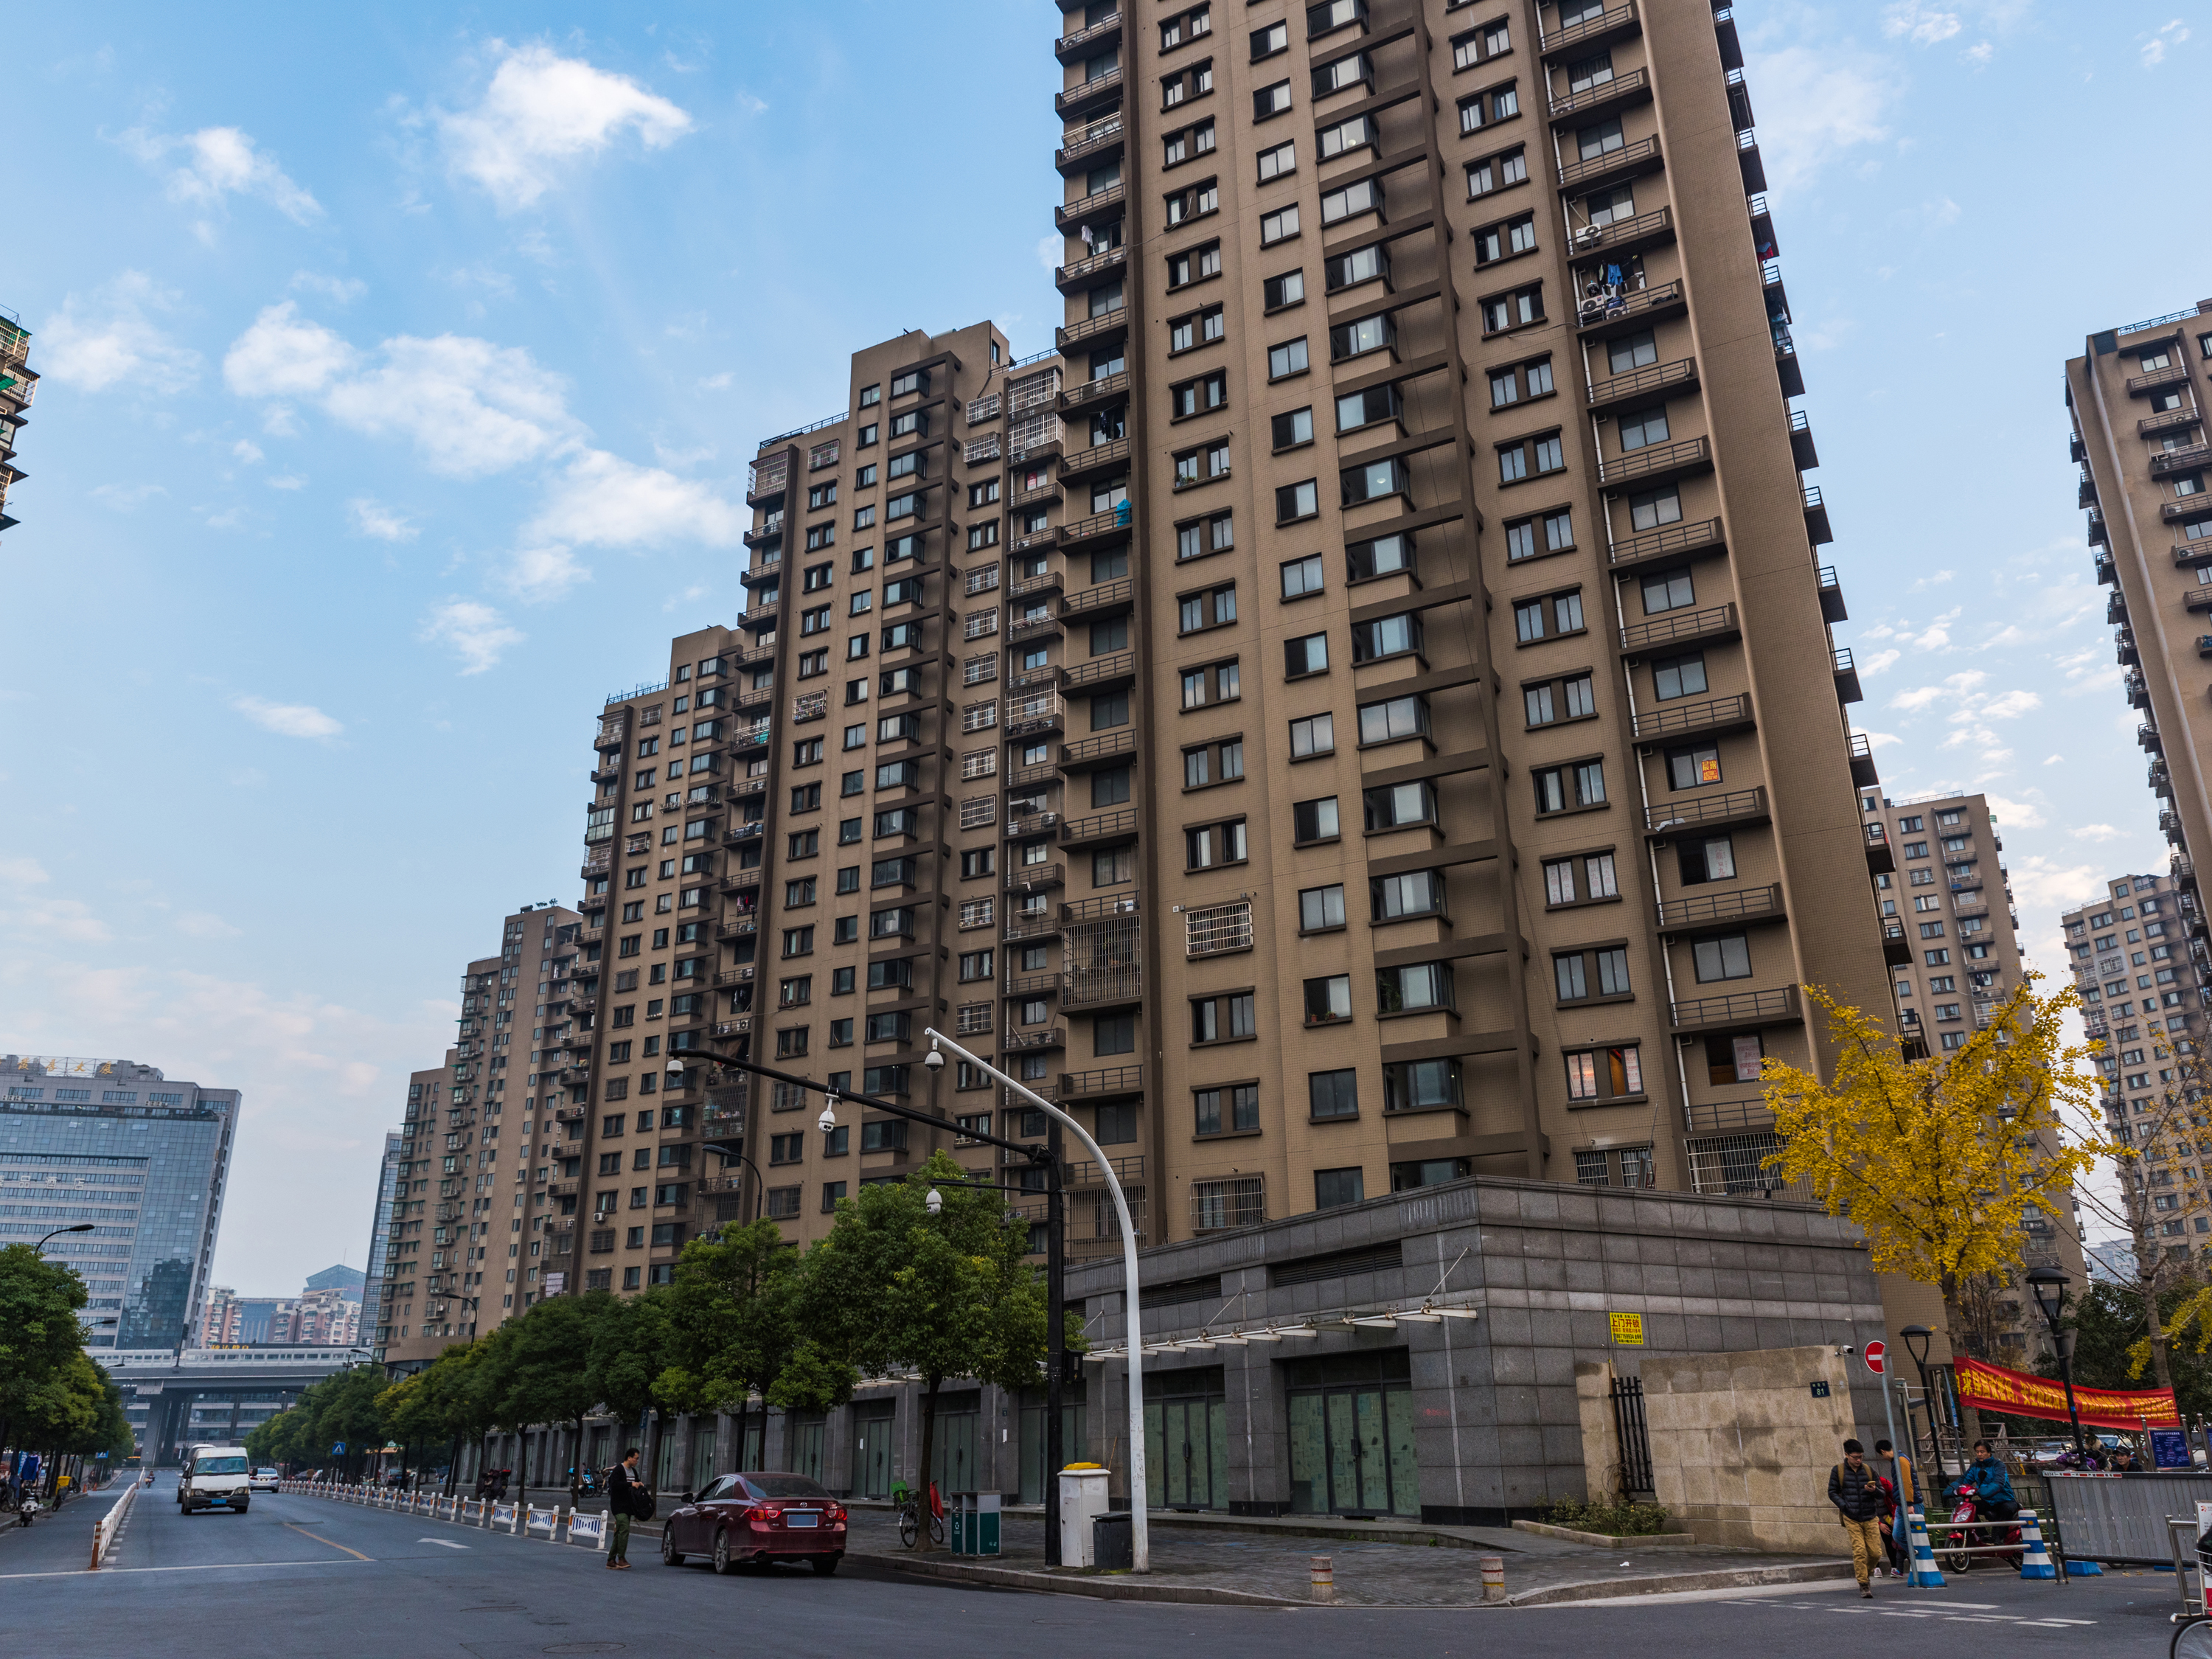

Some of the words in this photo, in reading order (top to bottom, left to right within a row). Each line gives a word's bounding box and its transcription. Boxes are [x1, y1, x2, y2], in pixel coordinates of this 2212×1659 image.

[1612, 1318, 1640, 1328] 上门开锁
[1816, 1388, 1825, 1396] 81
[641, 1409, 647, 1427] P
